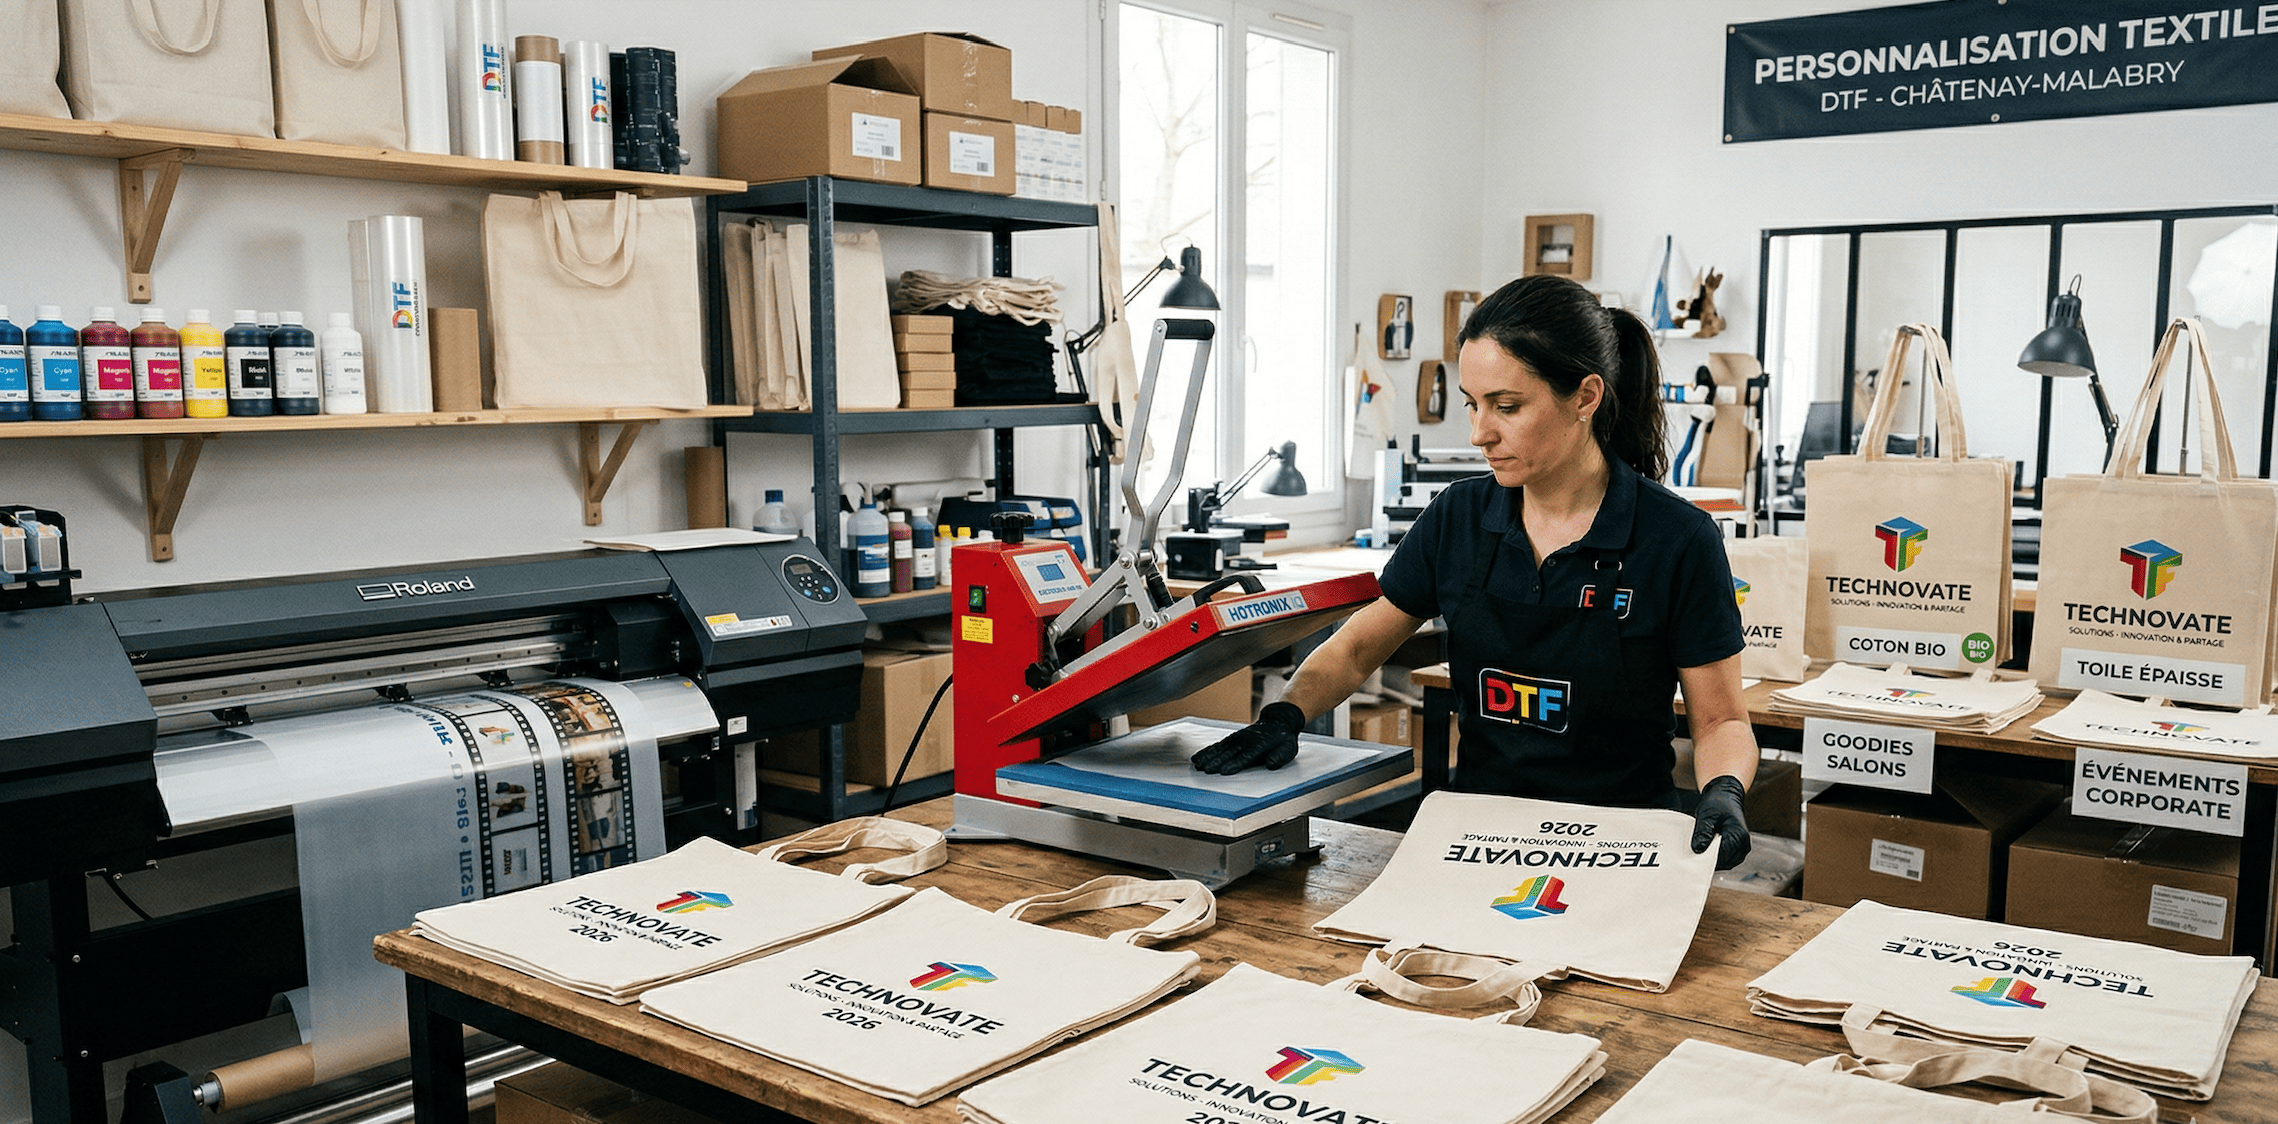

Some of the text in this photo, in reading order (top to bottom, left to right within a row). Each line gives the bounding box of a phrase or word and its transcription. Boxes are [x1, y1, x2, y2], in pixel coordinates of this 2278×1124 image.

[1755, 4, 2278, 84] PERSONNALISATION TEXTILE
[482, 44, 501, 92] DTF
[1821, 88, 1868, 112] DTF
[1890, 60, 2185, 107] CHÂTENAY-MALABRY
[590, 77, 608, 123] DTF
[392, 281, 413, 329] DTF
[391, 575, 476, 597] Roland
[1826, 576, 1972, 601] TECHNOVATE
[1228, 597, 1292, 622] HOTRONIX
[2063, 602, 2232, 635] TECHNOVATE
[1849, 637, 1946, 657] COTON BIO
[1967, 639, 1990, 651] BIO
[2068, 626, 2114, 638] SOLUTIONS
[2120, 631, 2174, 643] INNOVATION
[2184, 637, 2225, 648] PARTAGE
[2077, 660, 2223, 689] TOILE ÉPAISSE
[1486, 677, 1563, 721] DTF
[1823, 732, 1913, 756] GOODIES
[1827, 754, 1907, 777] SALONS
[2082, 760, 2240, 796] ÉVÉNEMENTS
[2085, 787, 2231, 820] CORPORATE
[1539, 821, 1598, 836] 2026
[1520, 838, 1587, 848] INNOVATION
[1596, 841, 1660, 849] SOLUTIONS
[1443, 844, 1660, 868] TECHNOVATE
[565, 896, 722, 948] TECHNOVATE
[568, 924, 618, 943] 2026
[1993, 941, 2062, 960] 2026
[1881, 941, 2154, 998] TECHNOVATE
[802, 969, 1005, 1035] TECHNOVATE
[821, 1007, 882, 1030] 2026
[1128, 1077, 1199, 1102] SOLUTIONS
[1141, 1058, 1393, 1124] TECHNOVAT
